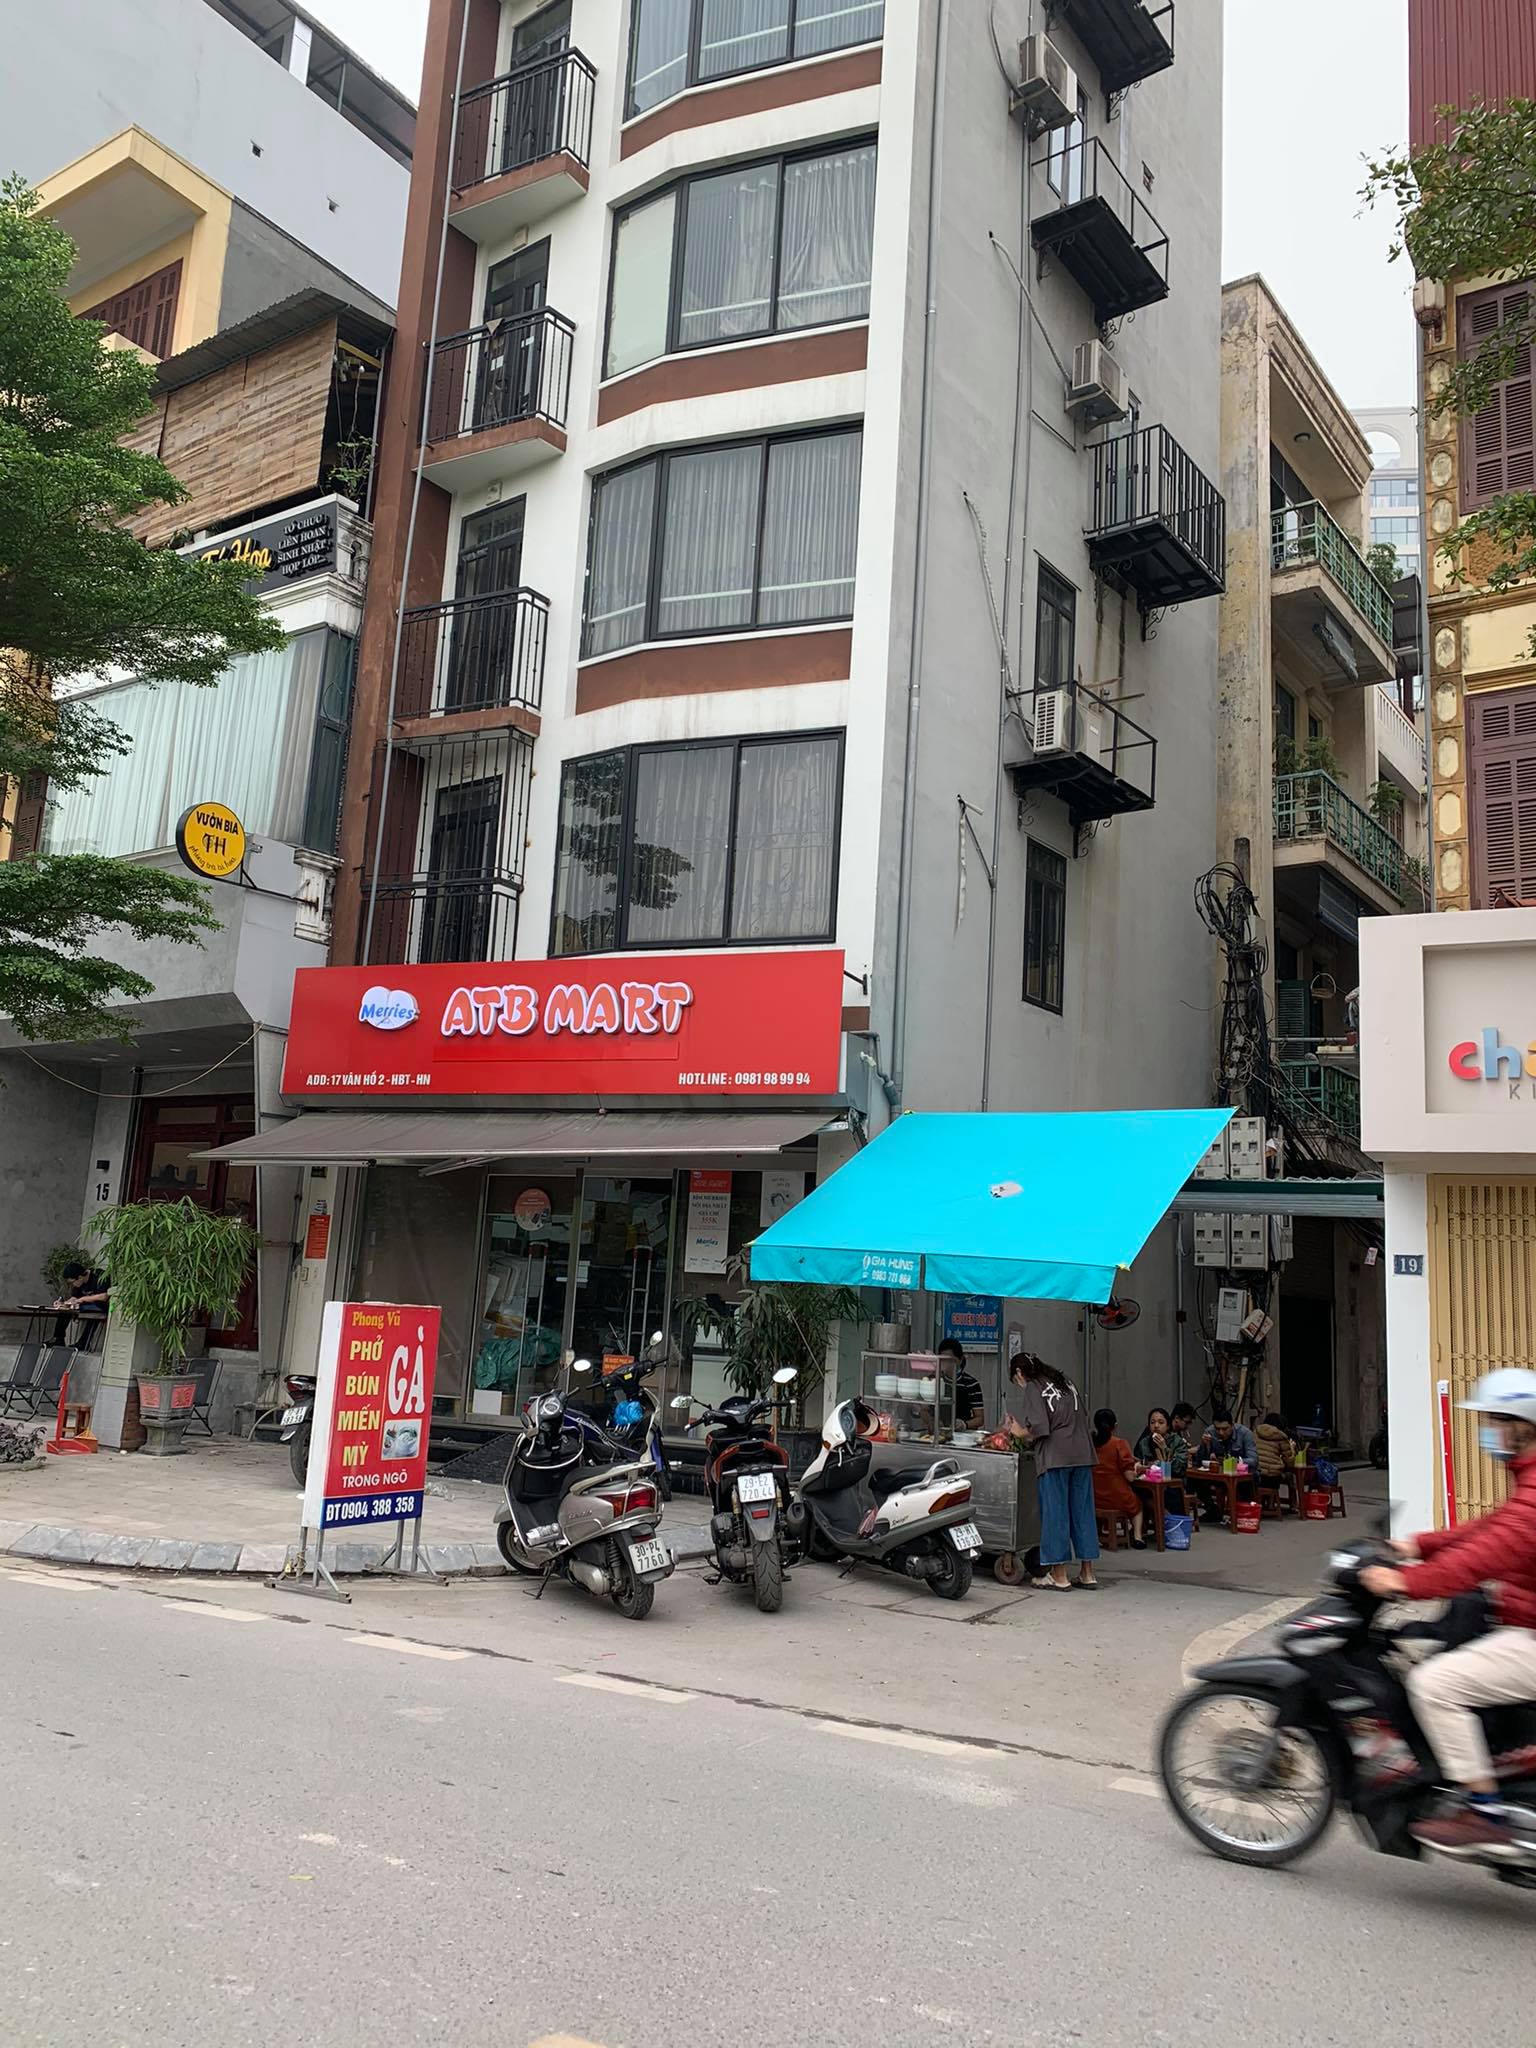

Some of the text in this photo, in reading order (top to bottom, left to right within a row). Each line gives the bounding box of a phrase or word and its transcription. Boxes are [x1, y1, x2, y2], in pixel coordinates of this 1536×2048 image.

[277, 539, 326, 563] SINH NHẬT
[278, 534, 299, 549] LIÊN
[196, 810, 239, 835] VƯỜN BIA
[361, 1003, 414, 1020] Merries
[440, 982, 693, 1037] ATB MART
[331, 1074, 341, 1085] 17
[342, 1072, 361, 1086] VÂN
[735, 1072, 761, 1085] 0981
[763, 1072, 778, 1085] 98
[779, 1072, 794, 1085] 99
[796, 1072, 811, 1085] 94
[95, 1183, 110, 1201] 15
[871, 1255, 886, 1267] GIA
[1400, 1257, 1418, 1273] 19
[351, 1310, 401, 1330] Phong Vũ
[349, 1335, 384, 1361] PHỞ
[387, 1325, 426, 1416] GÀ
[345, 1371, 380, 1396] BÚN
[337, 1404, 381, 1432] MIẾN
[342, 1441, 368, 1467] MỲ
[342, 1469, 408, 1489] TRONG NGÕ
[371, 1499, 392, 1517] 388
[395, 1497, 415, 1514] 358
[638, 1553, 665, 1571] 7760
